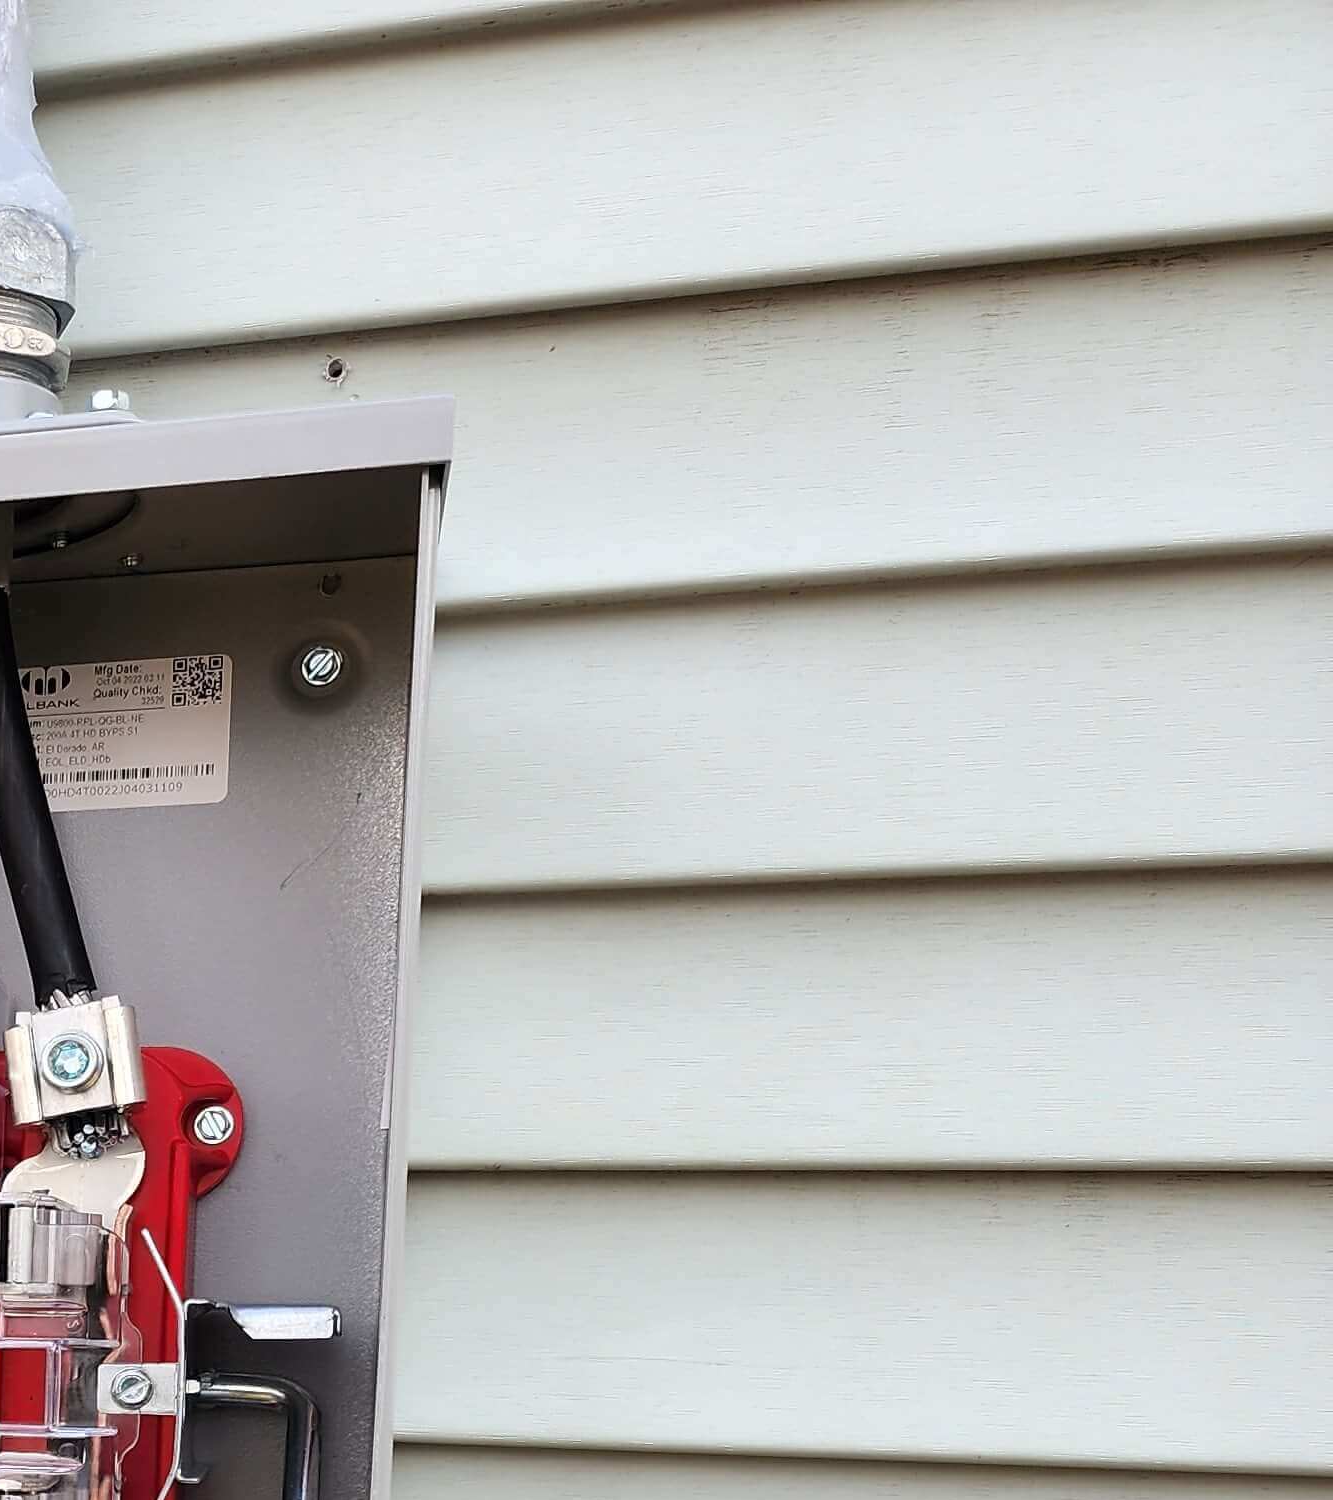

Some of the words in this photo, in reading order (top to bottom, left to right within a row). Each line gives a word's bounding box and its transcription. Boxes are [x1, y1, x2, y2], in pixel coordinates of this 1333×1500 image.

[95, 666, 113, 677] Mfg
[116, 664, 142, 674] Date:
[93, 688, 129, 699] Quality
[132, 685, 161, 696] Chkd:
[27, 698, 81, 710] LBANK
[92, 742, 105, 750] AR
